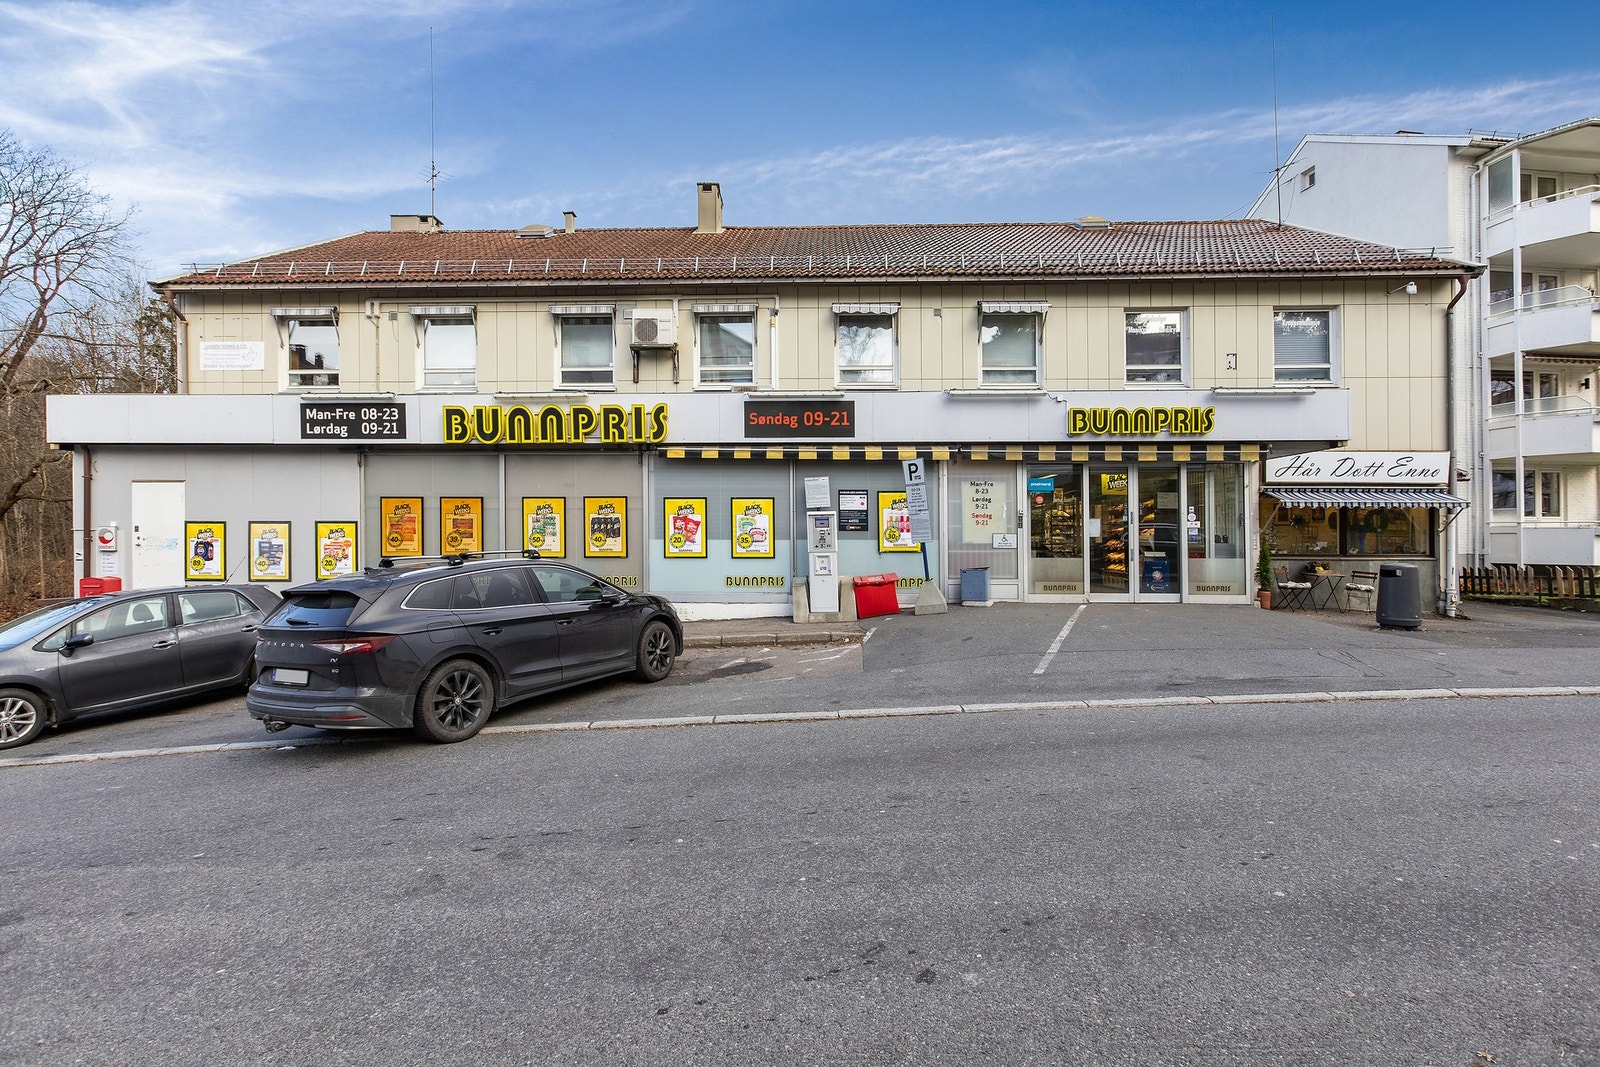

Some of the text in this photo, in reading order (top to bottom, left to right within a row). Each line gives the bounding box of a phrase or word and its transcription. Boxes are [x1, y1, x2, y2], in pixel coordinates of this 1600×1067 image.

[306, 408, 399, 420] Man-Fre 08-23
[749, 411, 850, 428] Søndag 09-21
[1069, 406, 1215, 435] BUNNPRIS
[306, 422, 399, 437] Lørdag 09-21
[443, 403, 668, 444] BUNNPRIS
[908, 463, 919, 481] P
[1274, 455, 1441, 478] Hår Dott Enno
[1107, 480, 1128, 489] WEEK
[1109, 473, 1128, 482] BLAC
[601, 575, 639, 587] NPRIS
[725, 576, 785, 588] BUNNPRIS
